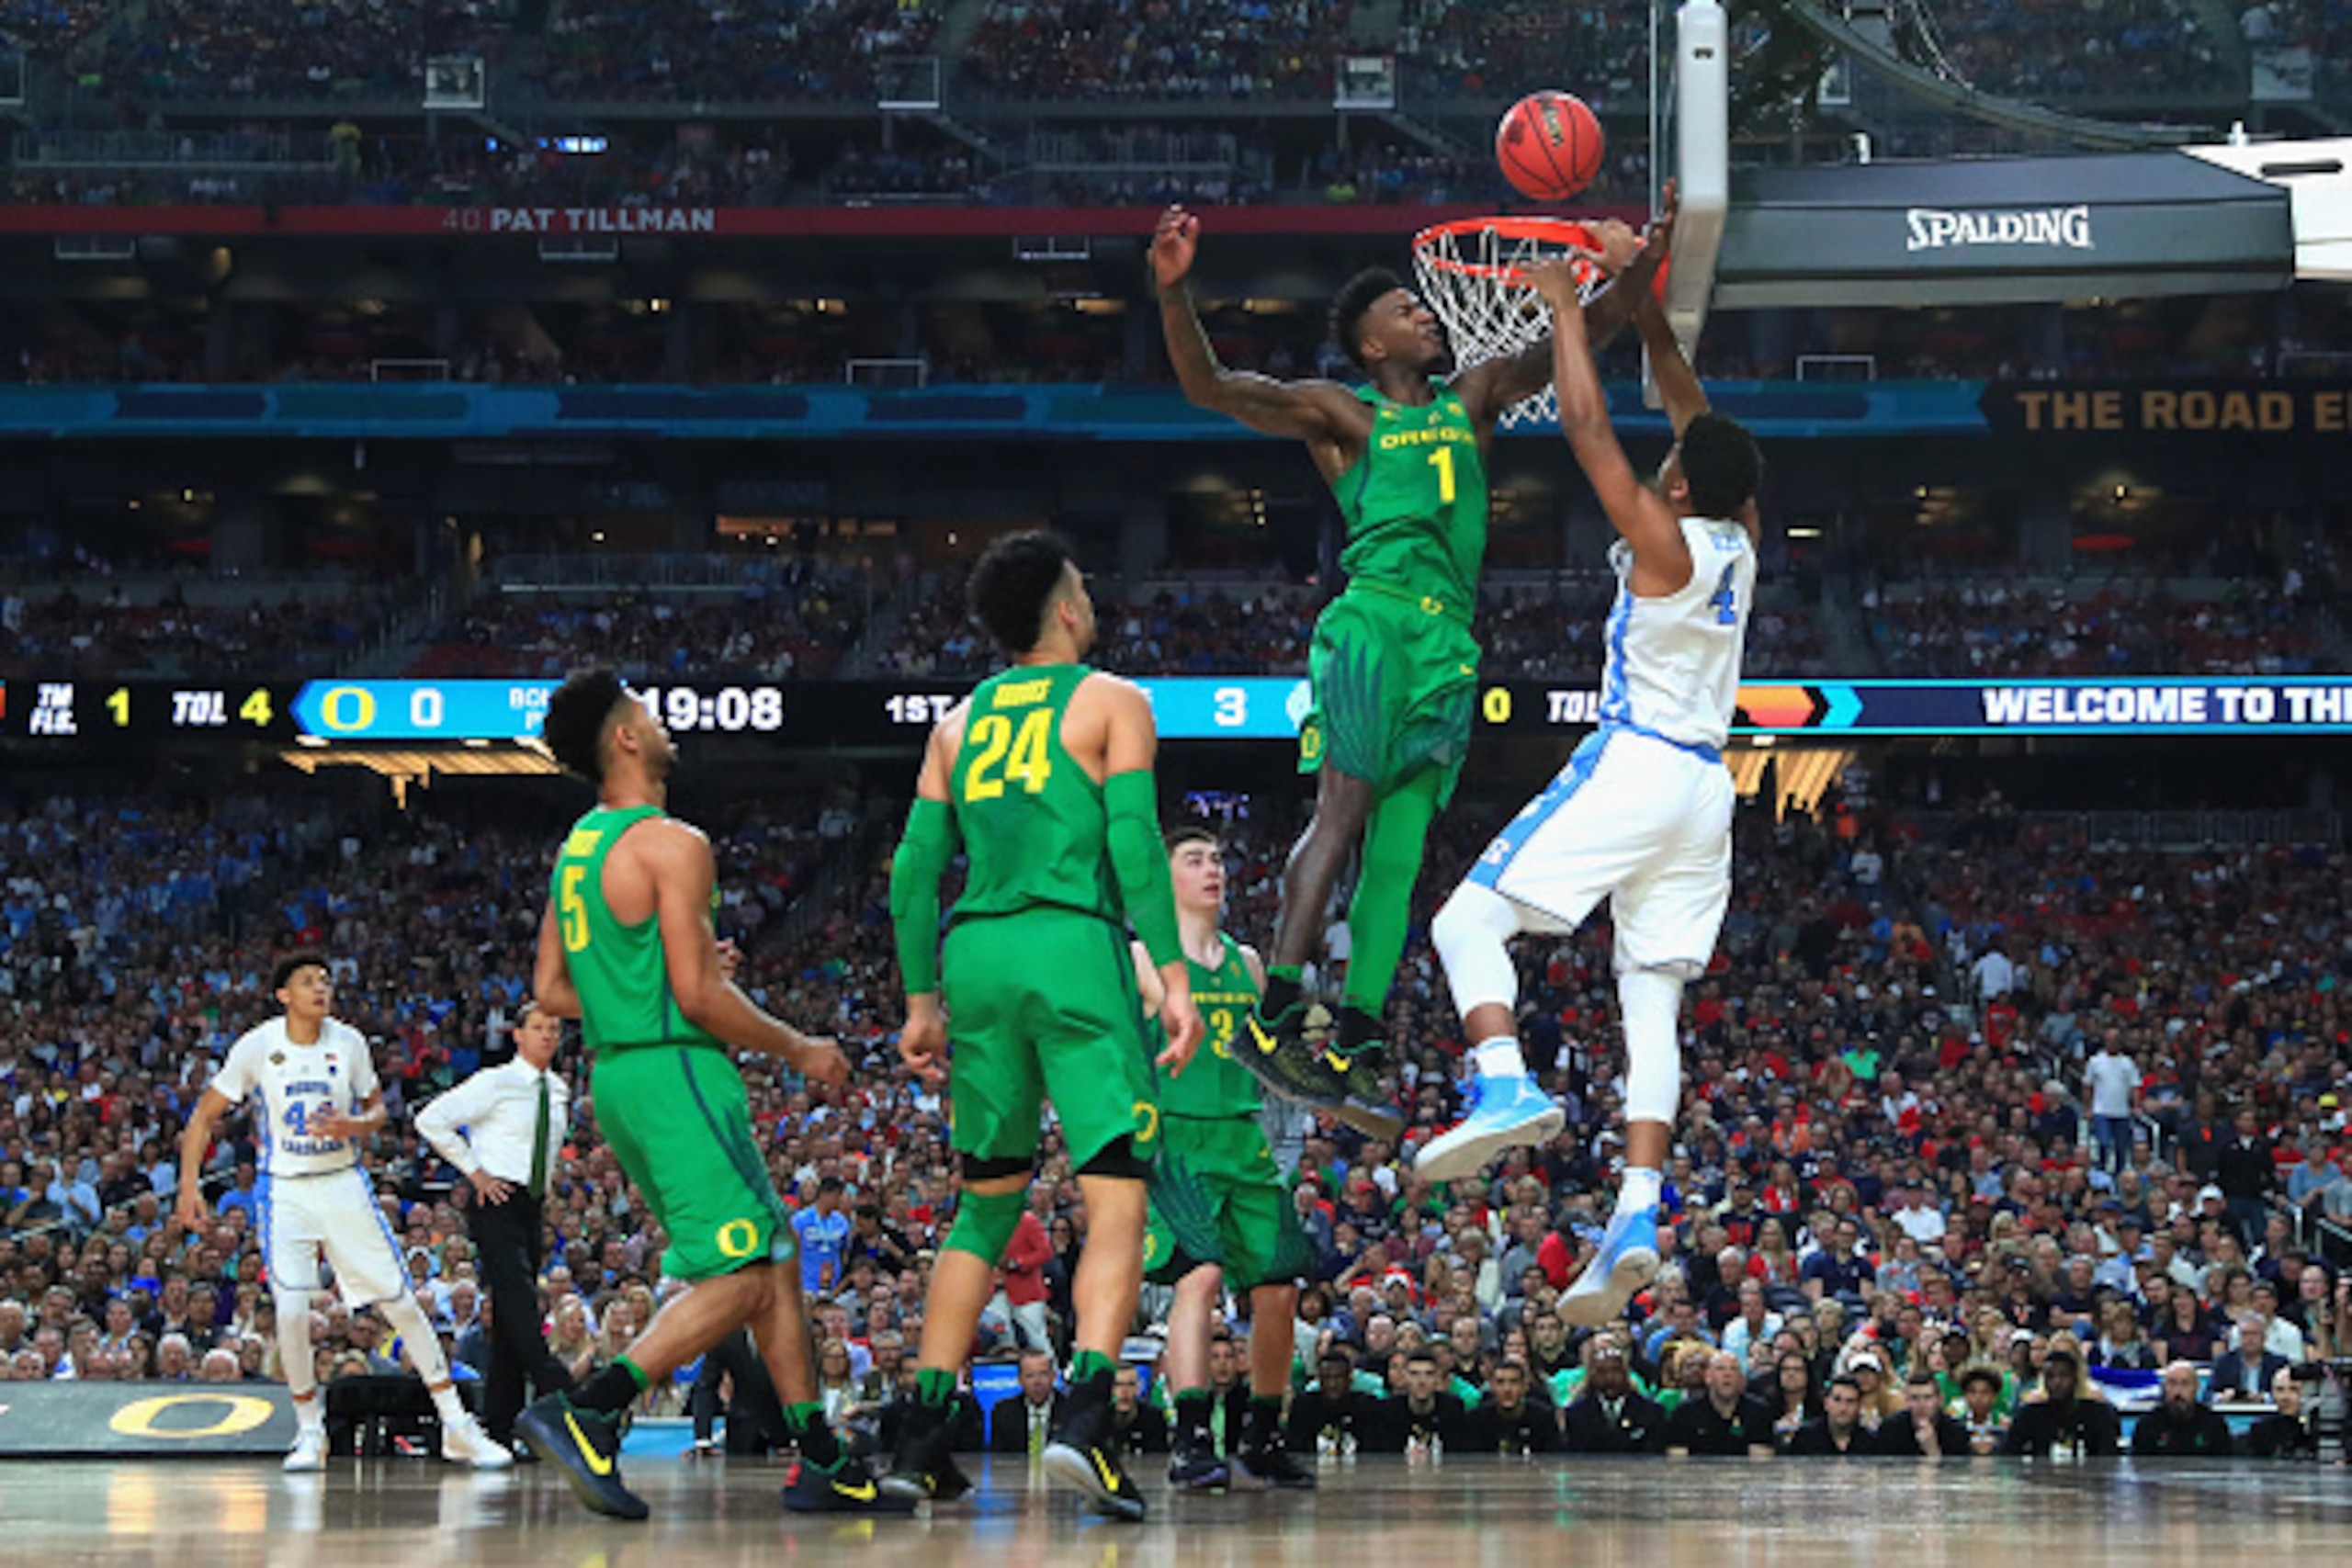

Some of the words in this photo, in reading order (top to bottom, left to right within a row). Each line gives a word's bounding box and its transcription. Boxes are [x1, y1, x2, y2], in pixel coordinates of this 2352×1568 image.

[490, 209, 555, 231] PAT
[565, 209, 715, 231] TILLMAN
[1906, 205, 2088, 251] SPALDING
[2016, 391, 2123, 429] THE
[2142, 391, 2293, 429] ROAD
[2314, 392, 2352, 430] E
[1428, 446, 1454, 502] 1
[1709, 562, 1736, 624] 4
[38, 682, 74, 706] TM
[106, 688, 130, 727] 1
[172, 691, 228, 725] TOL
[239, 687, 274, 727] 4
[411, 688, 443, 727] 0
[644, 688, 782, 731] 19:08
[886, 695, 953, 722] 1ST
[1215, 687, 1247, 727] 3
[1483, 687, 1511, 723] 0
[1547, 691, 1600, 723] TOL
[1984, 687, 2207, 723] WELCOME
[2216, 687, 2275, 723] TO
[966, 707, 1054, 801] 24
[561, 865, 591, 952] 5
